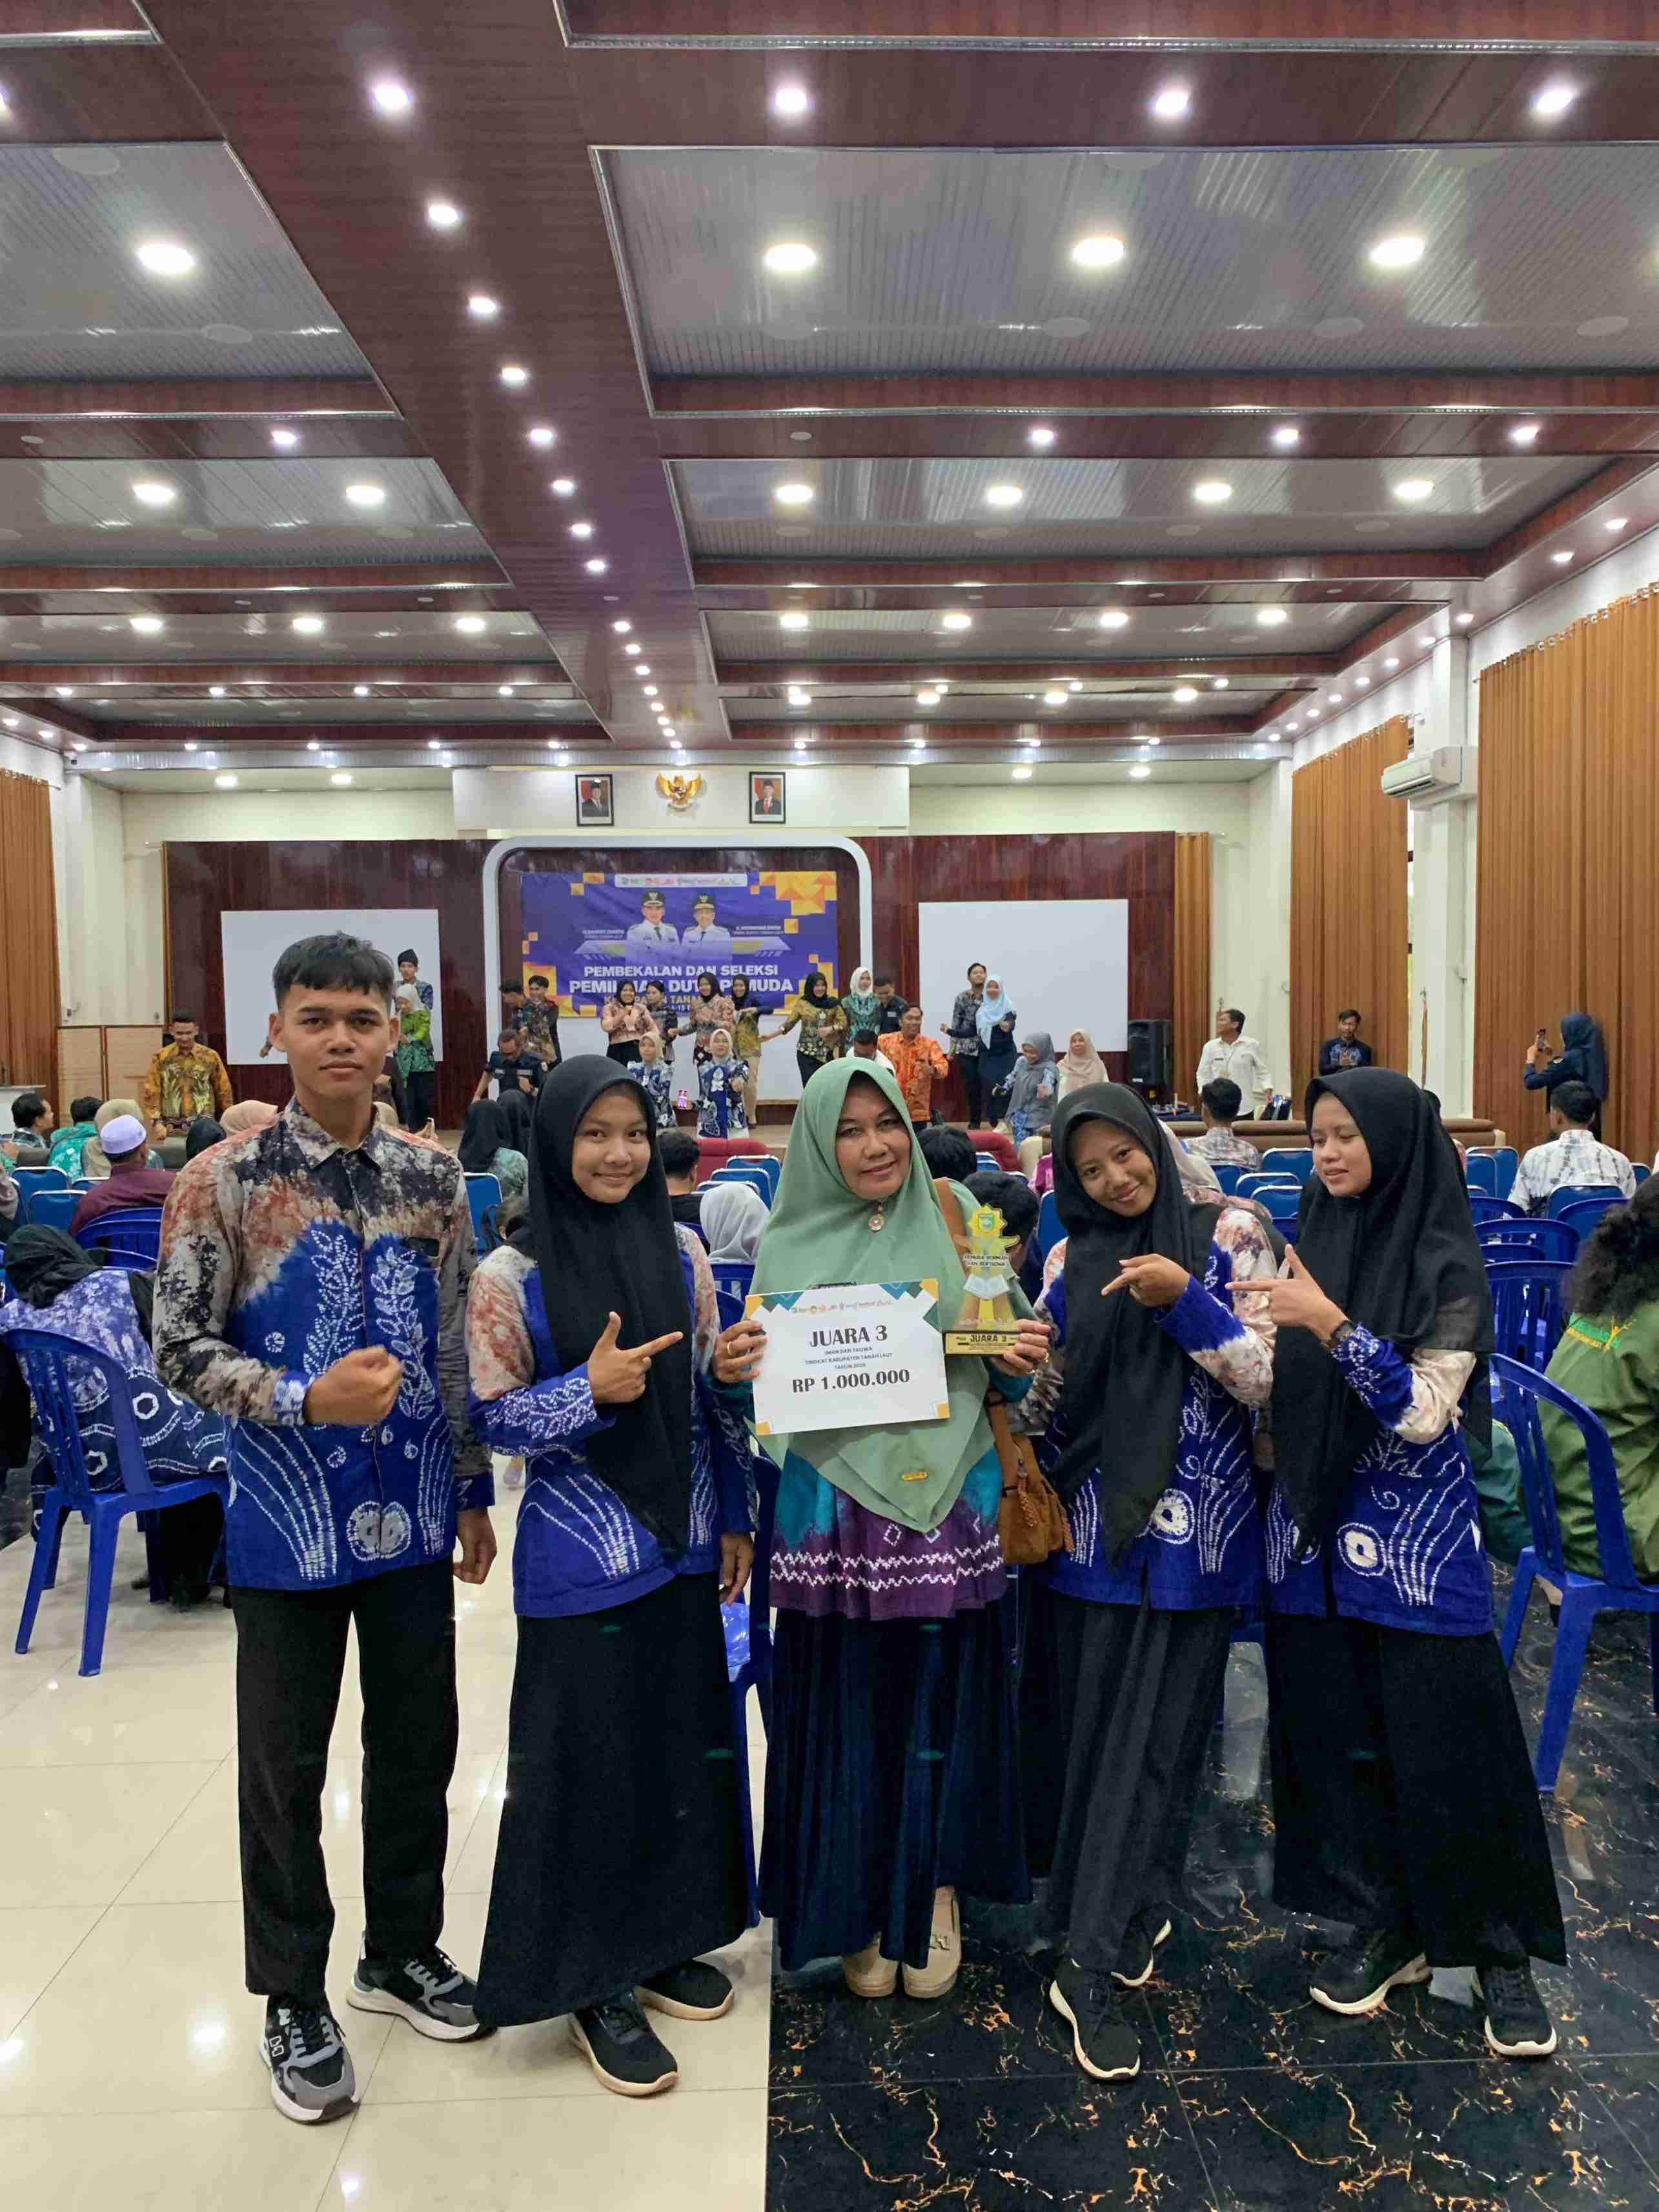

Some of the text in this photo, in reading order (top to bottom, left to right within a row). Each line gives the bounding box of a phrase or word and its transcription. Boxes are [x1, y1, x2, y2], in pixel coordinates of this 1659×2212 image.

[584, 964, 779, 977] PEMBEKALAN DAN SELEKSI
[668, 979, 700, 993] DUT
[719, 979, 794, 992] PMUDA
[809, 1324, 888, 1347] JUARA 3
[792, 1368, 910, 1393] RP 1.000.000
